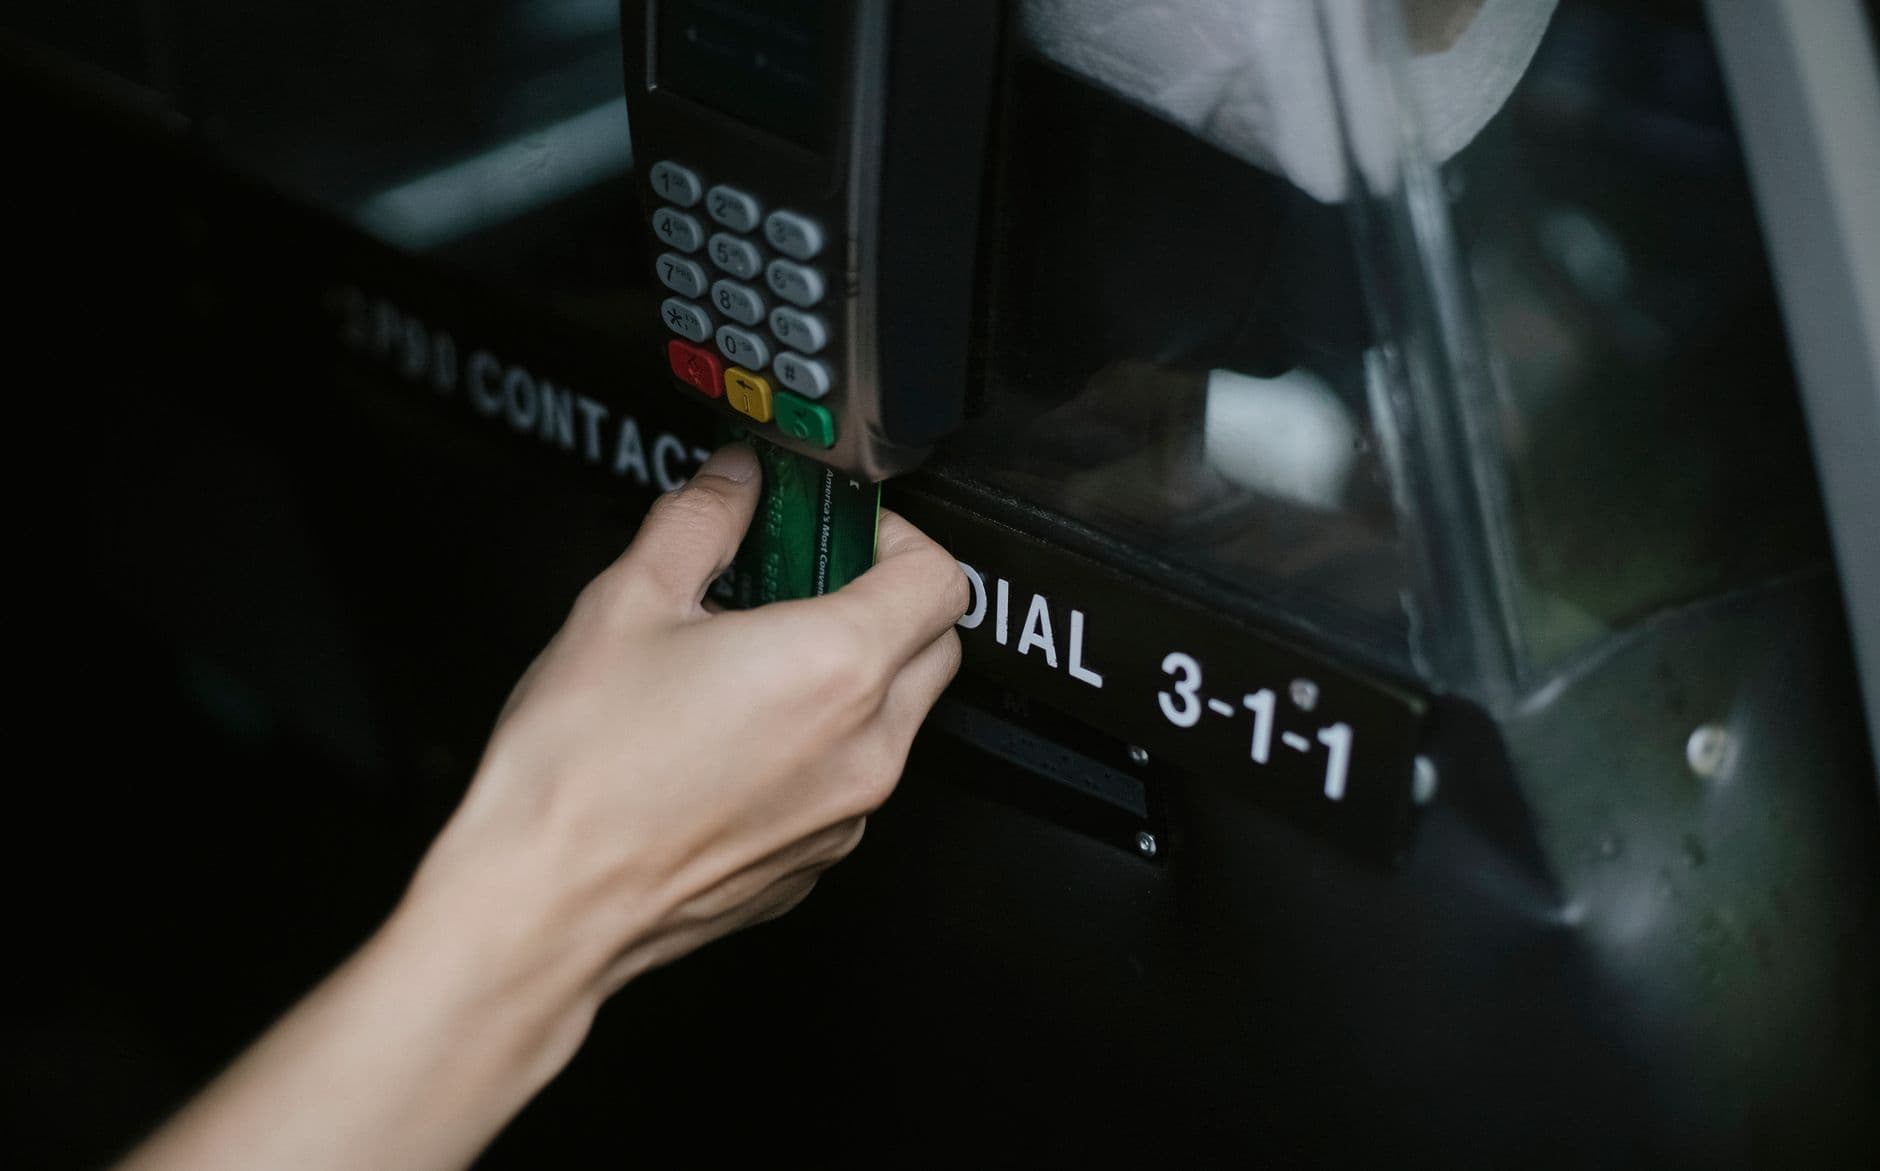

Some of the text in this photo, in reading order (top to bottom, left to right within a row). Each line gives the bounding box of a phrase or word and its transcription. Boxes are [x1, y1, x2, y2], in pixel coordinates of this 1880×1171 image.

[661, 172, 669, 193] 1
[717, 195, 727, 218] 2
[661, 217, 673, 238] 4
[717, 242, 729, 264] 5
[663, 262, 673, 282] 7
[719, 289, 731, 310] 8
[777, 316, 789, 337] 9
[725, 335, 737, 355] 0
[820, 524, 831, 553] Most
[816, 554, 829, 597] Conven
[1157, 651, 1354, 801] 3-1-1
